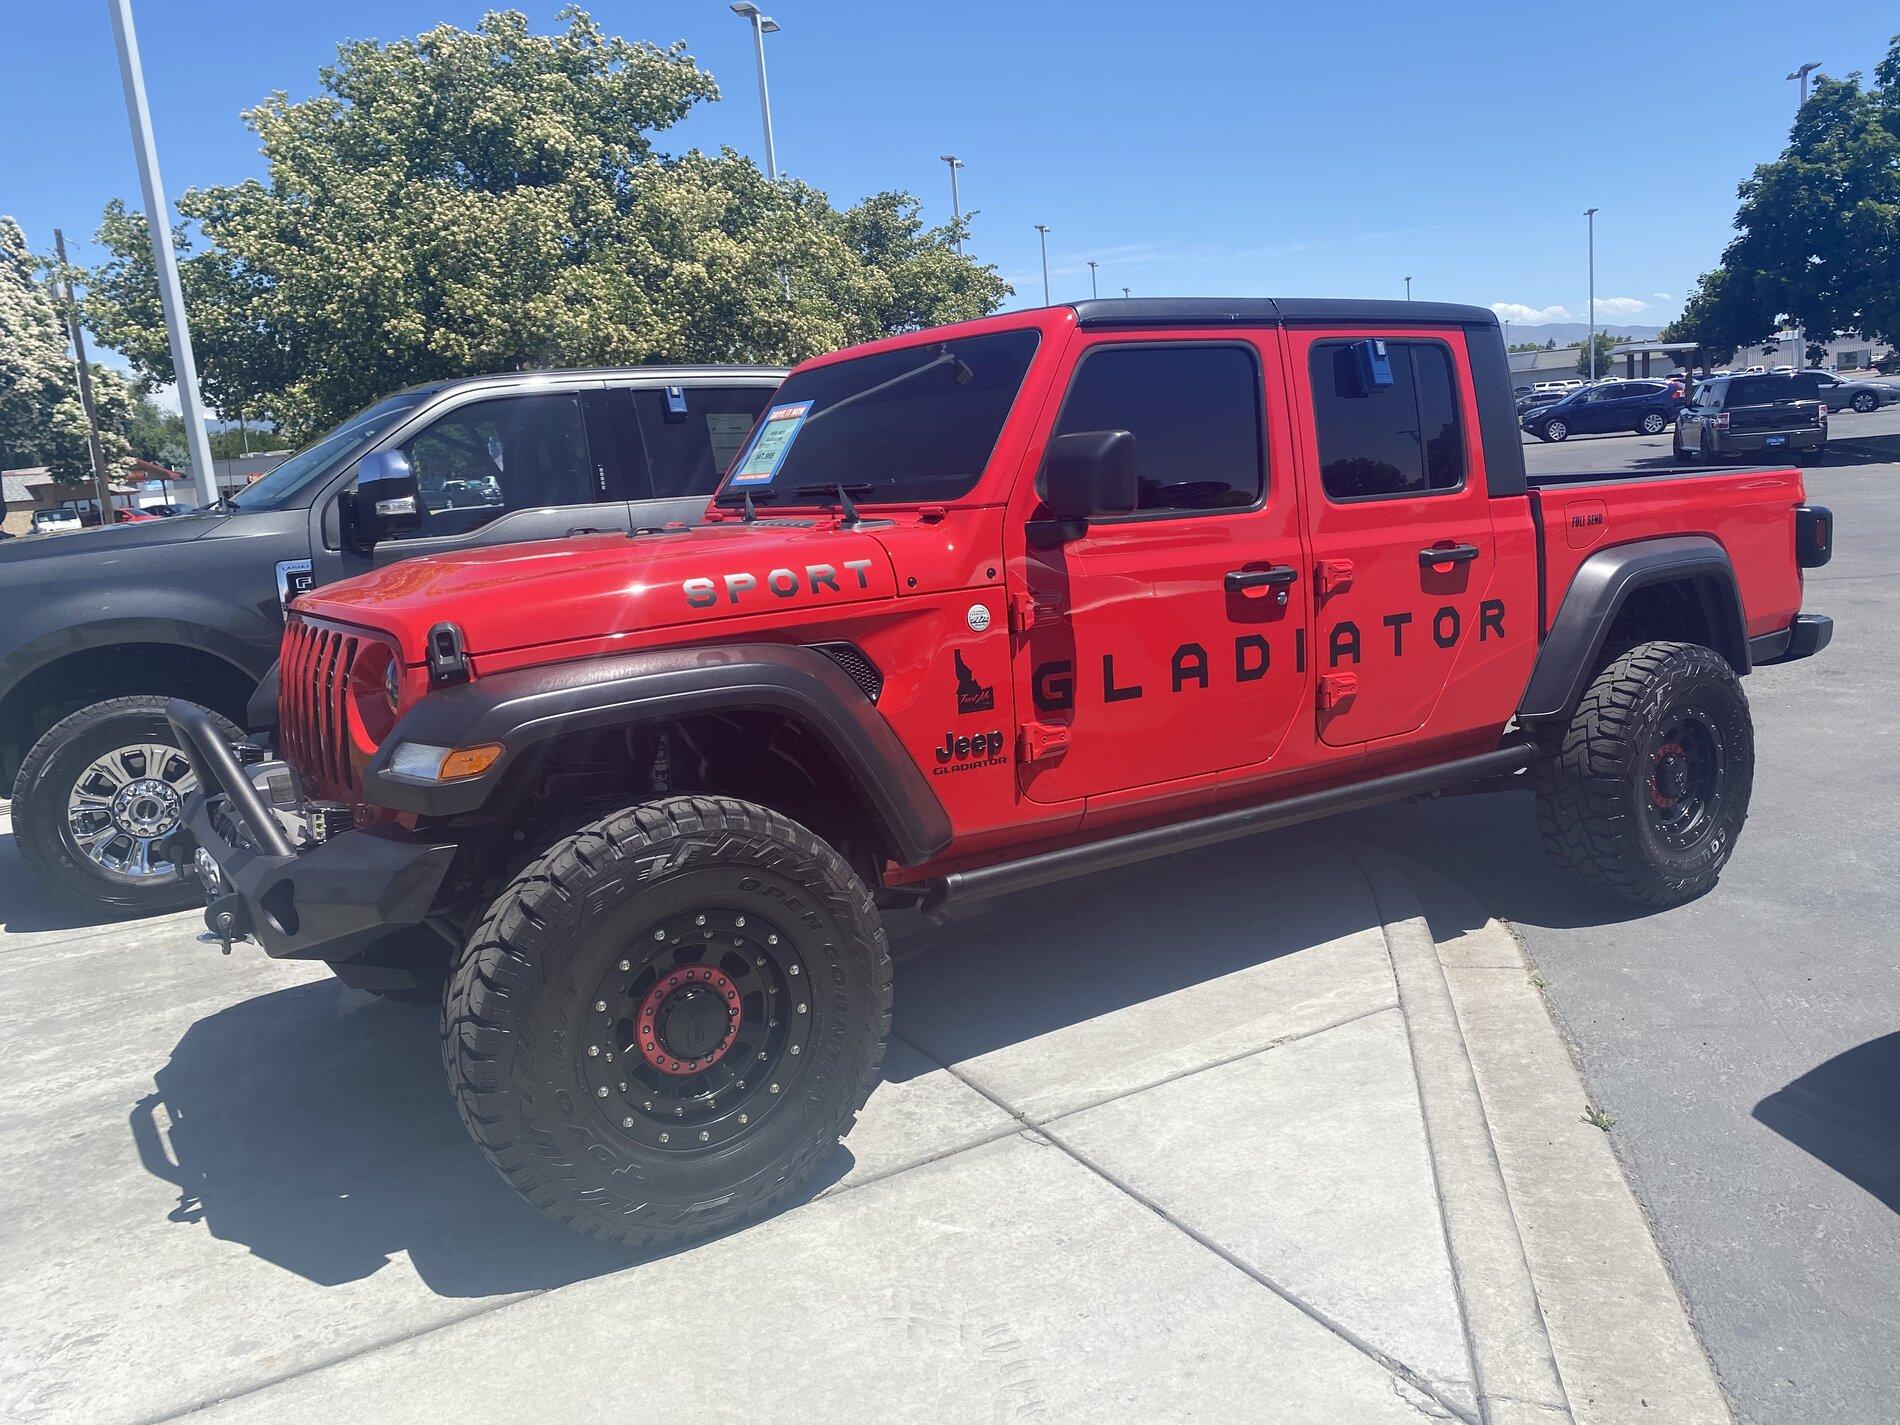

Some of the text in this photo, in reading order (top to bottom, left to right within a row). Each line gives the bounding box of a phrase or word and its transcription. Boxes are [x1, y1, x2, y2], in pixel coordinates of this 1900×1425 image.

[1572, 514, 1603, 528] FULL SEND
[682, 559, 872, 609] SPORT
[1032, 598, 1506, 712] GLADIATOR
[932, 756, 1007, 776] GLADIATOR
[935, 731, 1004, 765] Jeep
[737, 876, 825, 932] OPEN
